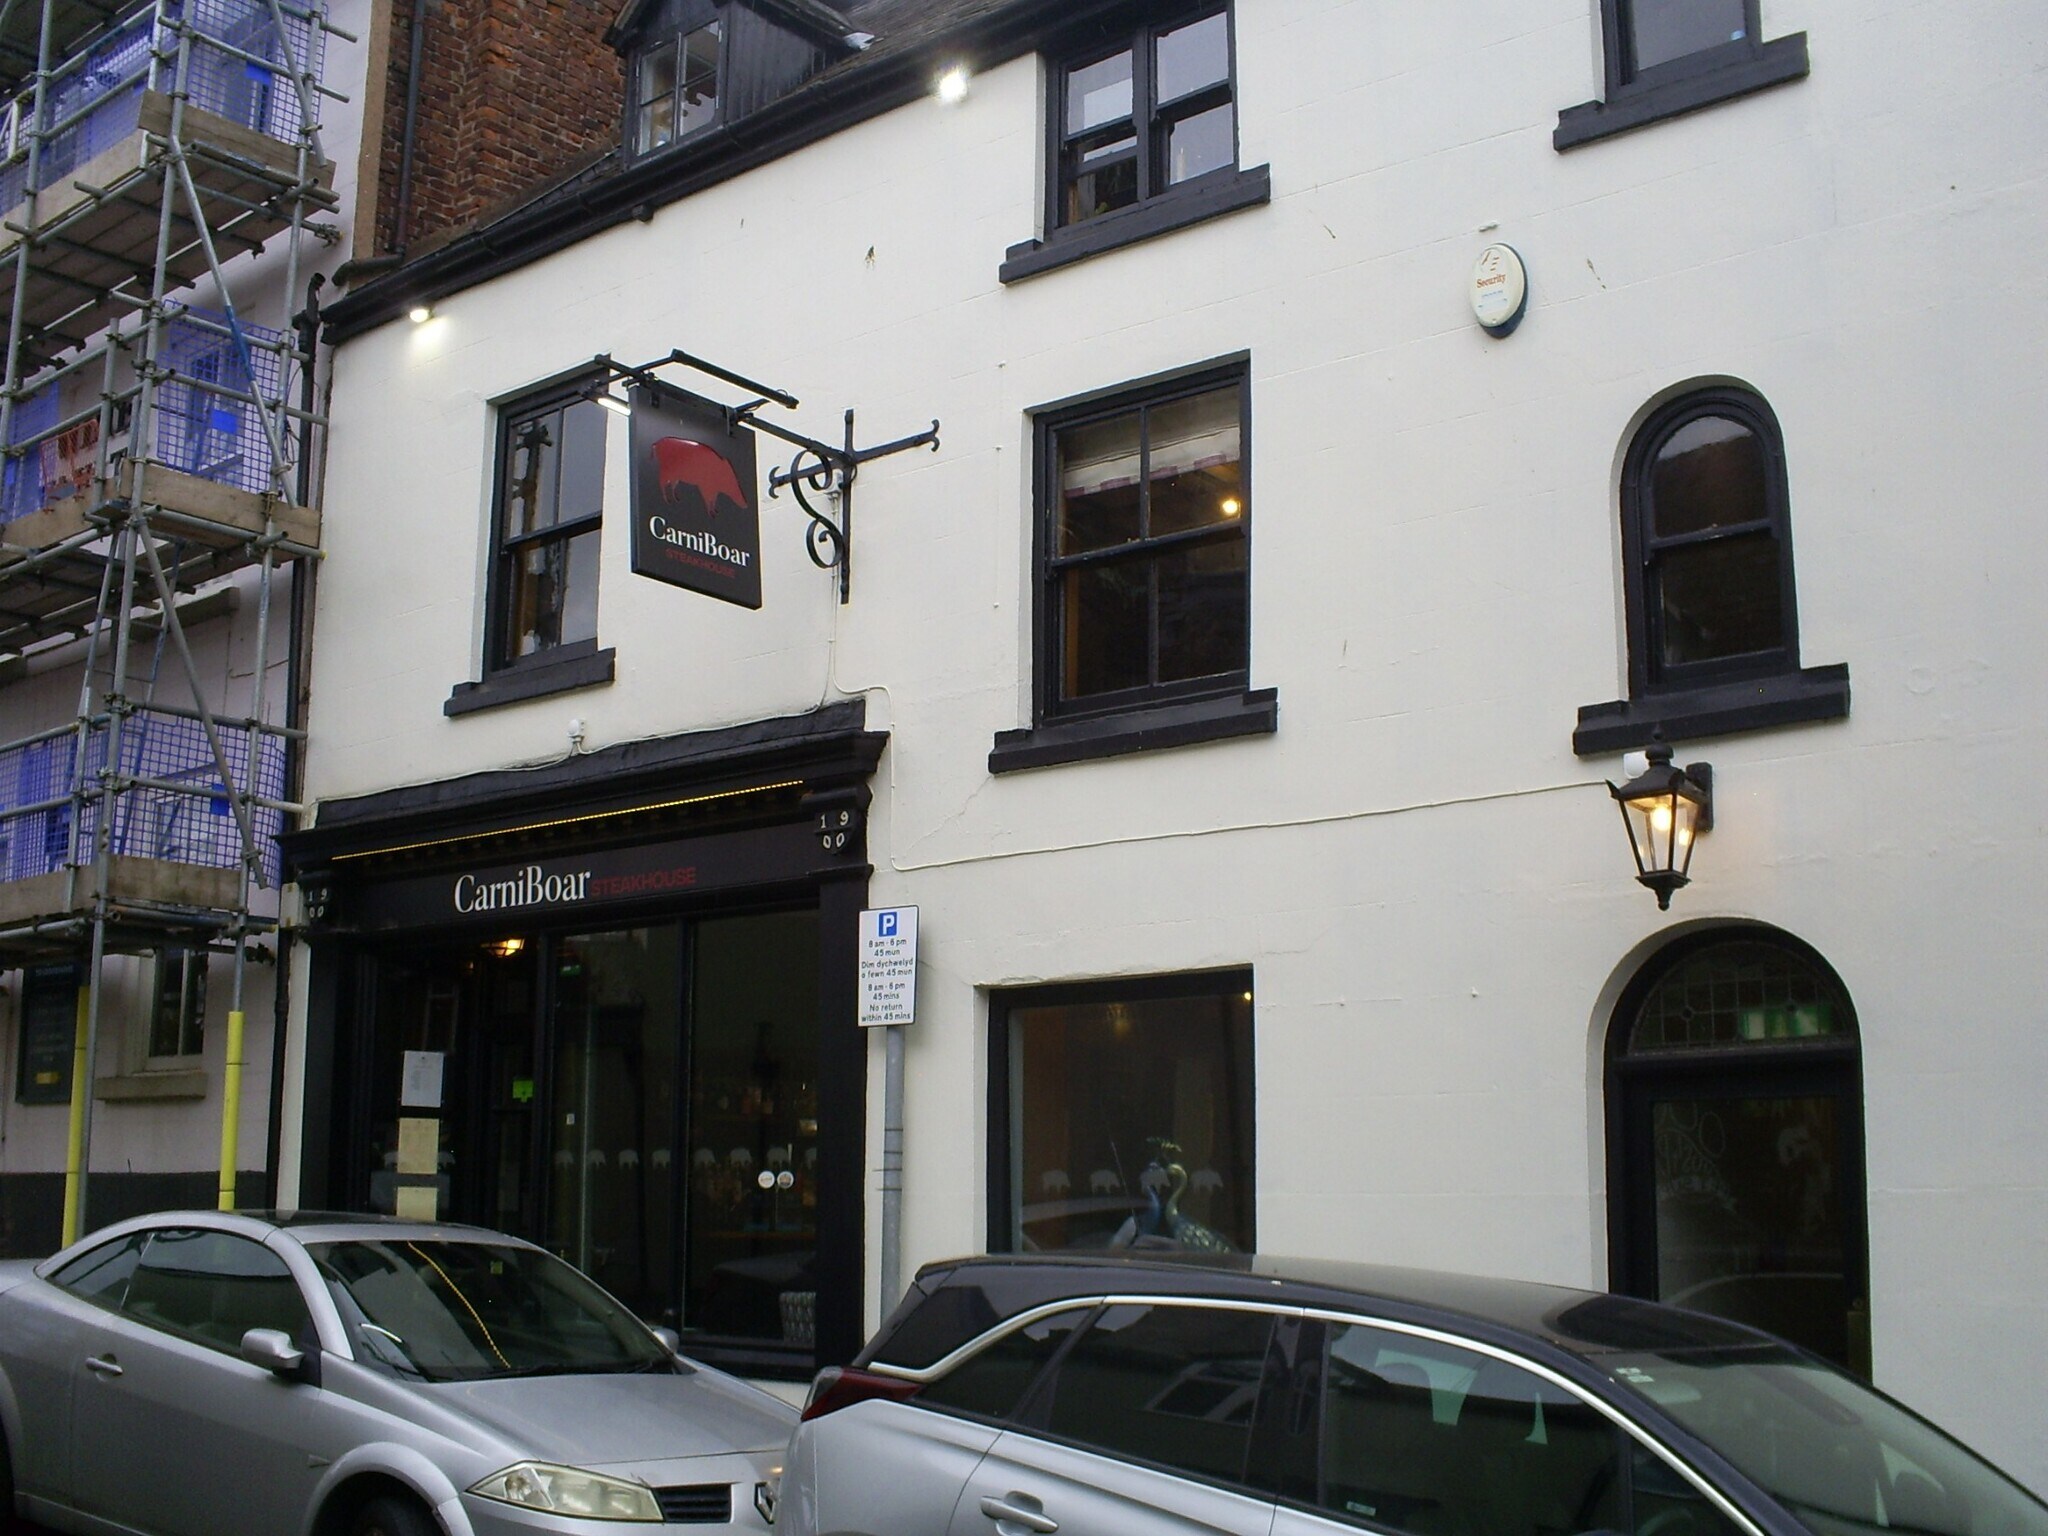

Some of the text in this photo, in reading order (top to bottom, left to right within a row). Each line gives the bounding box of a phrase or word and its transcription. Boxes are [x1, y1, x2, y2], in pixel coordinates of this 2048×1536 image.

[1476, 274, 1506, 288] Security
[649, 515, 751, 567] CarniBoar
[454, 865, 697, 913] CarniBoar STEAKHOUSE
[882, 914, 895, 935] P
[896, 939, 907, 947] pm
[874, 949, 884, 957] 45
[861, 958, 914, 969] Dim dychwelyd
[867, 970, 885, 979] fewn
[886, 968, 896, 976] 45
[897, 968, 913, 976] mun
[894, 982, 906, 991] pm
[873, 992, 900, 1001] 45 mins
[869, 1003, 903, 1012] No return
[861, 1012, 911, 1022] within 45 mins
